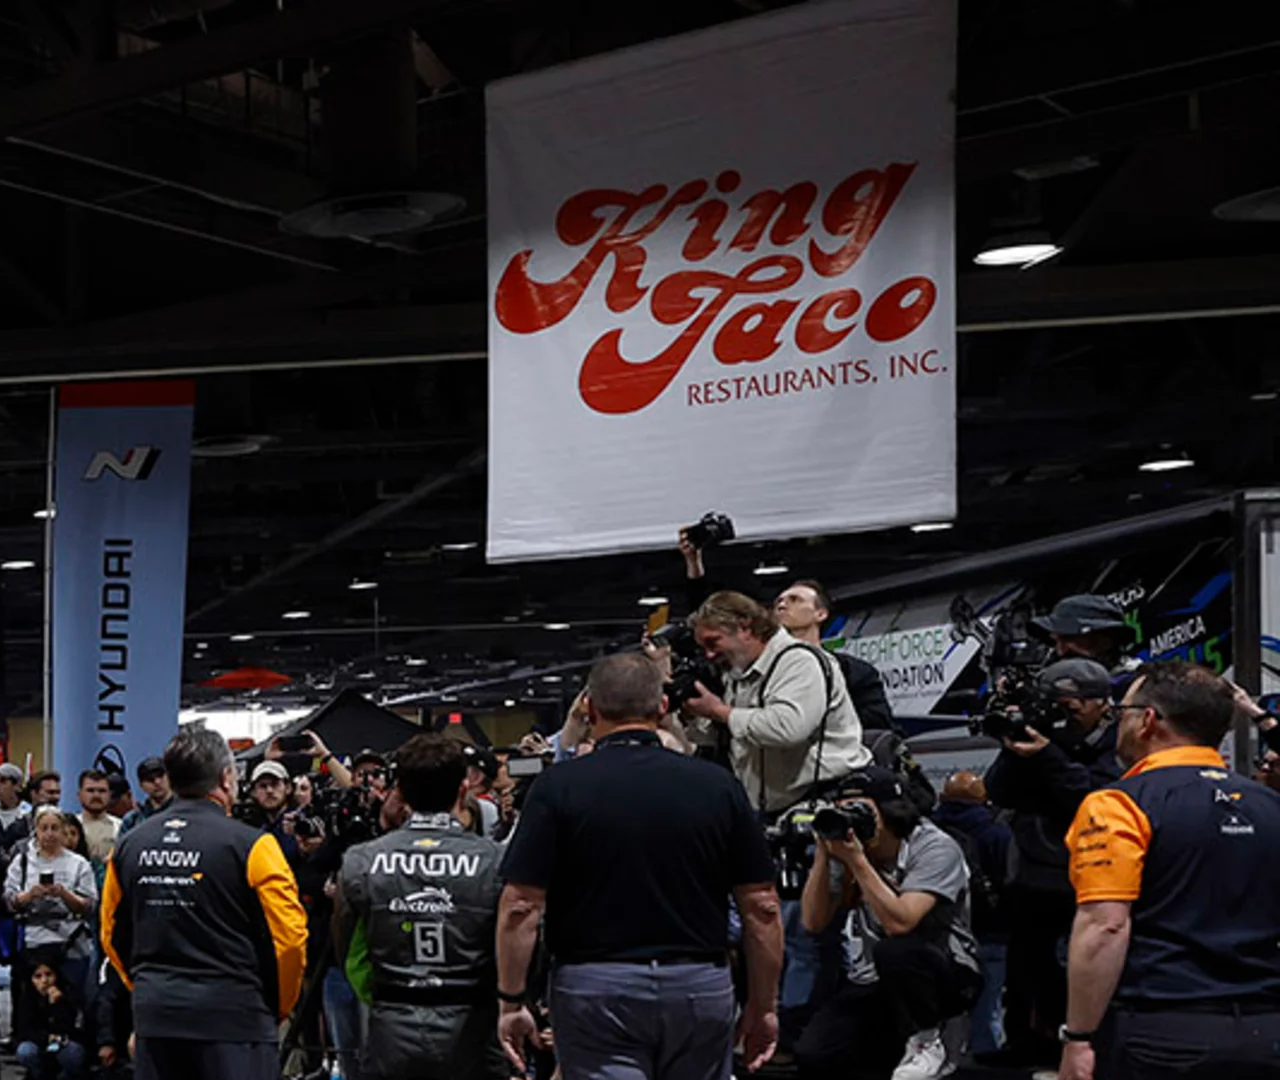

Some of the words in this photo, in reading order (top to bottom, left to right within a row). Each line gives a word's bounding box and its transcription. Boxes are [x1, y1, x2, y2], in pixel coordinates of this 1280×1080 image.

[494, 160, 919, 334] King
[579, 255, 937, 415] Taco
[687, 360, 878, 406] RESTAURANTS,
[890, 350, 948, 379] INC.
[97, 539, 133, 731] HYUNDAI
[1149, 615, 1207, 658] AMERICA
[881, 661, 945, 690] NDATION
[139, 849, 200, 867] ARROW
[370, 853, 479, 877] ARROW
[420, 926, 438, 958] 5
